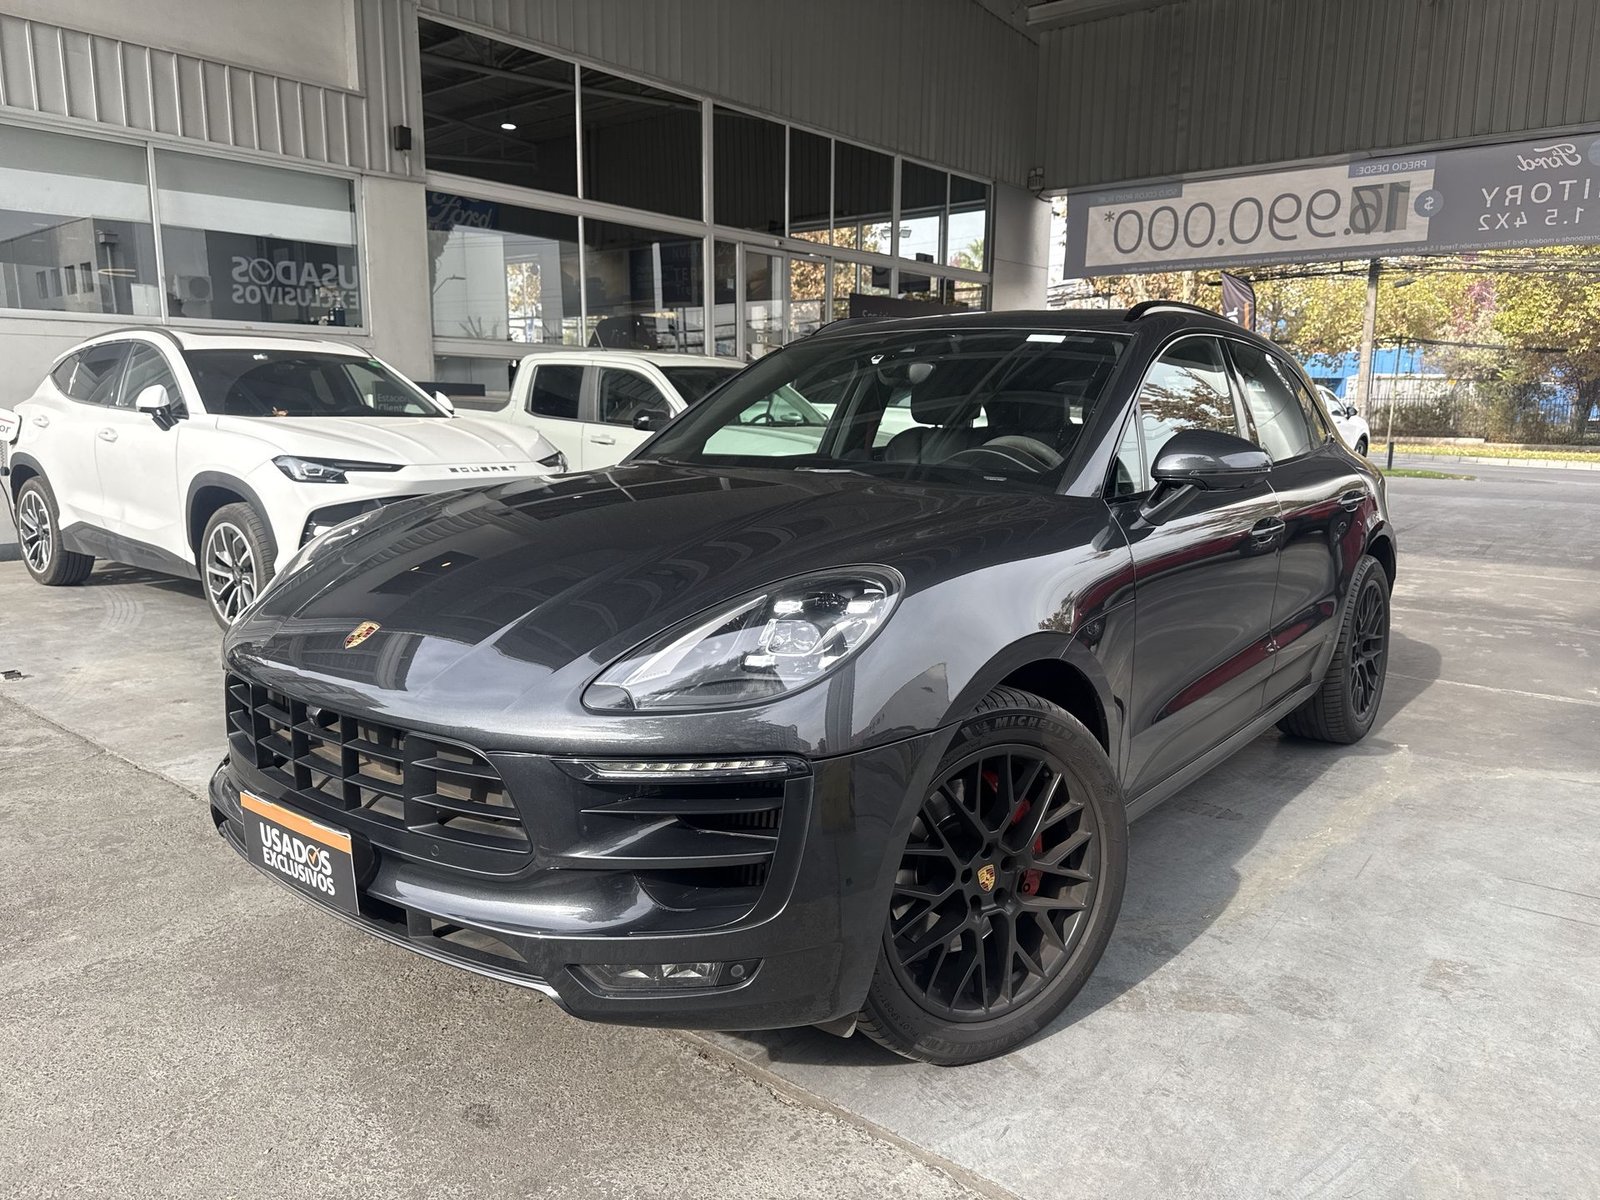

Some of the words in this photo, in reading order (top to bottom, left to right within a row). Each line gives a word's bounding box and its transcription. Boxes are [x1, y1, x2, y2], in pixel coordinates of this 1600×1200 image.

[994, 715, 1073, 739] MICHELIN
[260, 822, 332, 876] USADOS
[262, 847, 336, 896] EXCLUSIVOS
